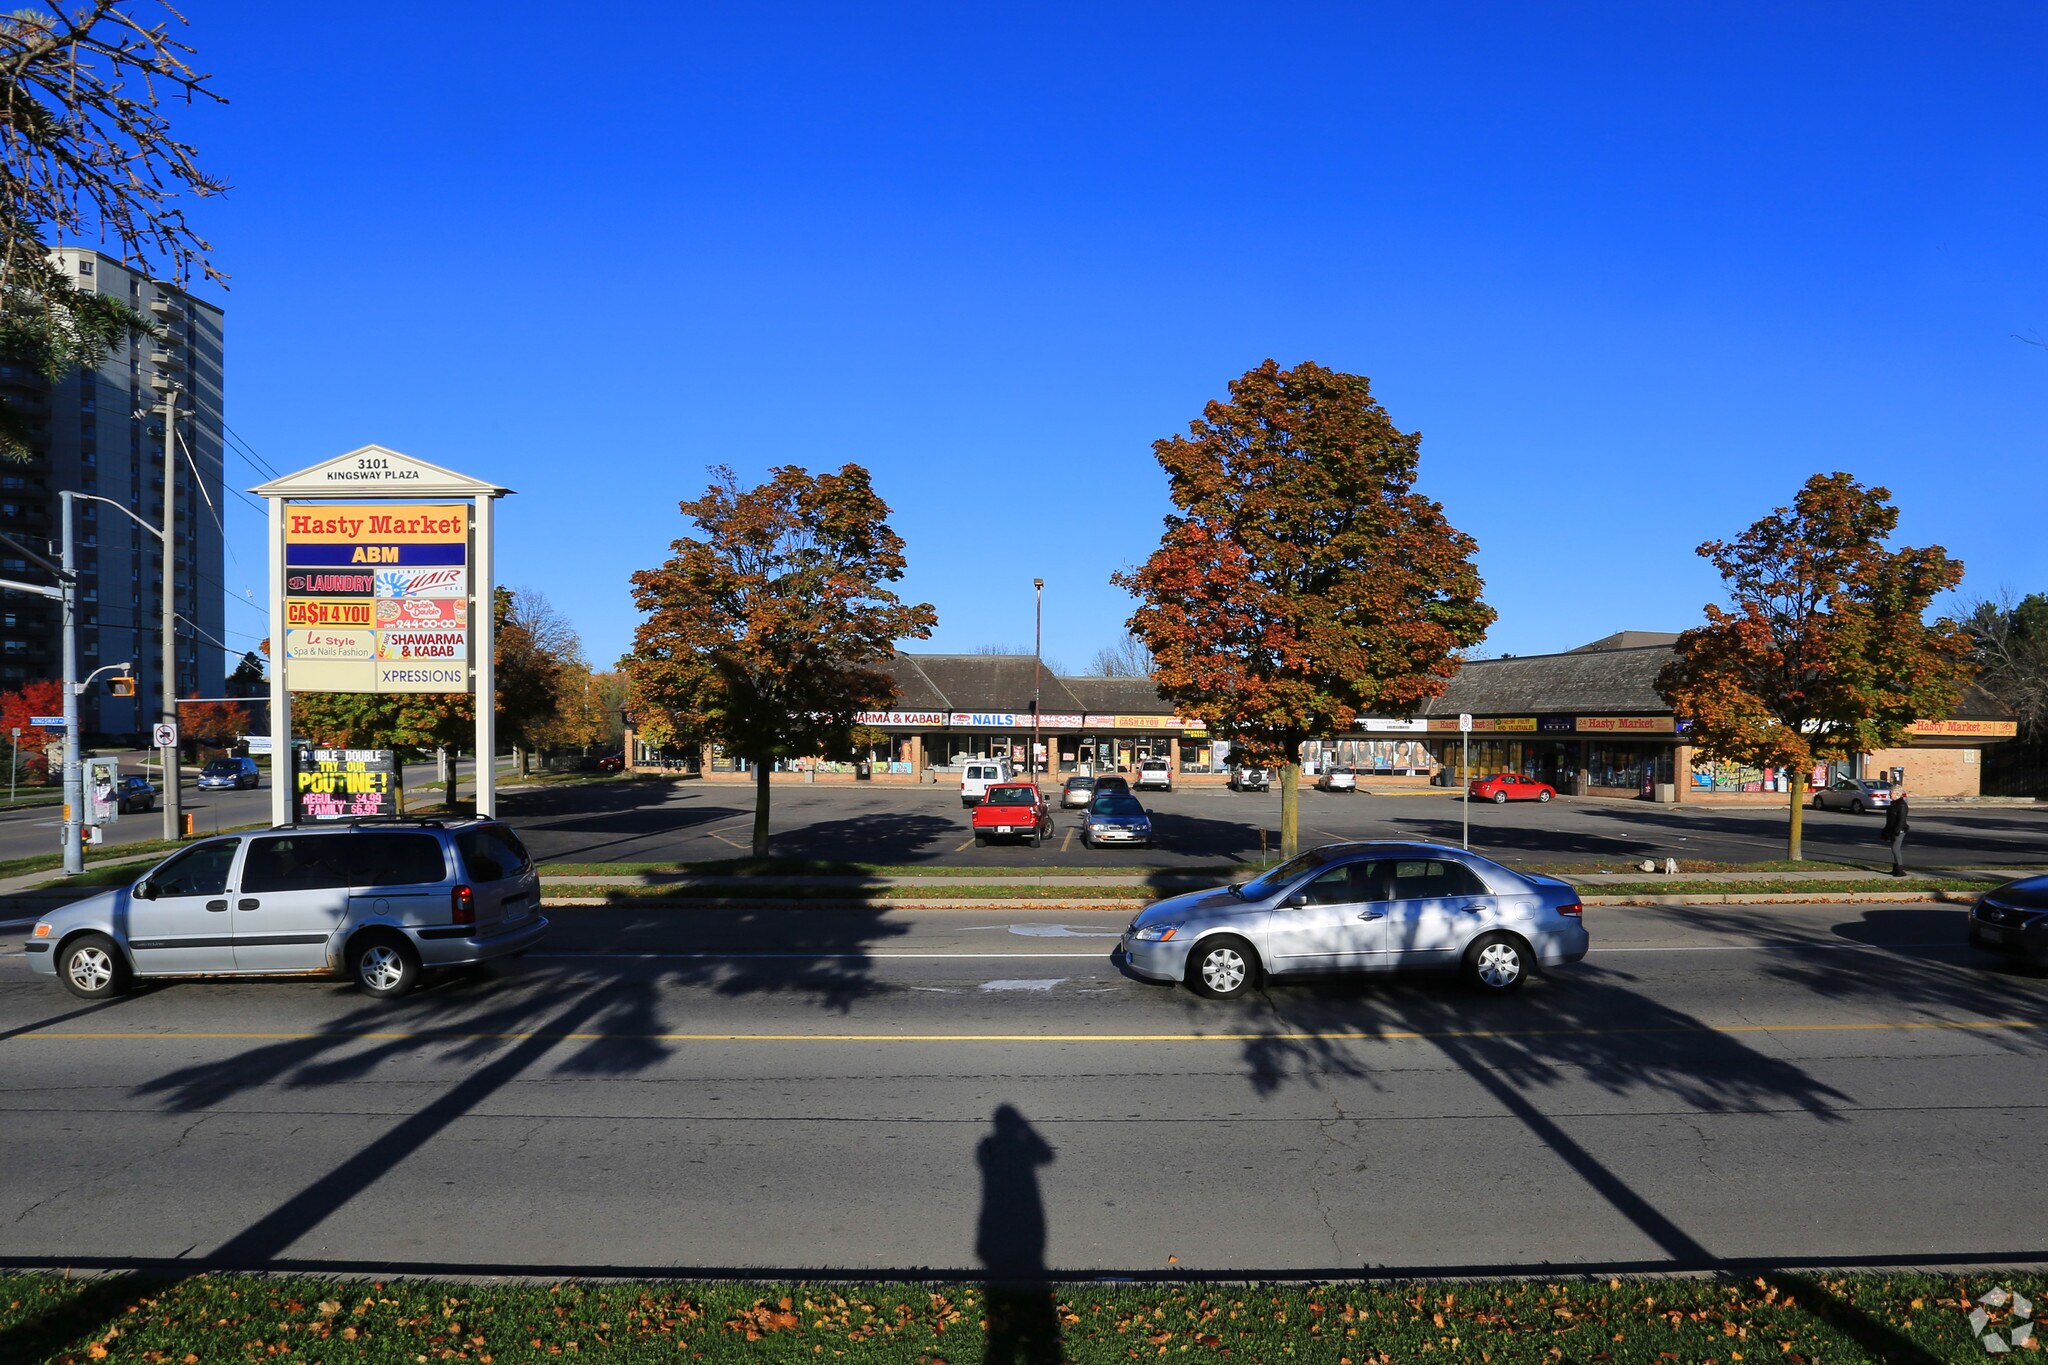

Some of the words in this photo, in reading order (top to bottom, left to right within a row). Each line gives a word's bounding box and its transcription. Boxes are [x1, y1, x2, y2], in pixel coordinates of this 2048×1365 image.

[358, 458, 389, 469] 3101
[327, 471, 382, 480] KINGSWAY
[385, 471, 420, 480] PLAZA
[291, 516, 364, 538] Hasty
[369, 516, 461, 534] Market
[352, 547, 399, 563] ABM
[306, 575, 373, 592] LAUNDRY
[406, 570, 461, 591] HAIR
[407, 601, 434, 610] Double
[289, 602, 328, 625] CA$H
[331, 606, 340, 621] 4
[343, 606, 370, 622] YOU
[413, 609, 440, 617] Double
[307, 631, 321, 645] Le
[325, 637, 356, 647] Style
[391, 634, 464, 645] SHAWARMA
[294, 647, 309, 656] Spa
[310, 647, 317, 656] &
[318, 647, 337, 656] Nails
[338, 648, 369, 656] Fashion
[401, 646, 411, 657] &
[414, 646, 455, 657] KABAB
[382, 670, 462, 682] XPRESSIONS
[893, 713, 902, 724] &
[904, 714, 940, 724] KABAB
[973, 715, 1013, 725] NAILS
[1439, 720, 1459, 730] Hasty
[1588, 719, 1615, 730] Hasty
[1618, 719, 1654, 729] Market
[1916, 721, 1944, 733] Hasty
[1947, 722, 1981, 732] Market
[301, 750, 338, 761] DOUBLE
[345, 750, 382, 762] DOUBLE
[319, 762, 339, 772] TRY
[346, 762, 366, 772] OUR
[355, 793, 382, 804] $4.99
[307, 804, 345, 815] FAMILY
[351, 805, 378, 815] $6.99
